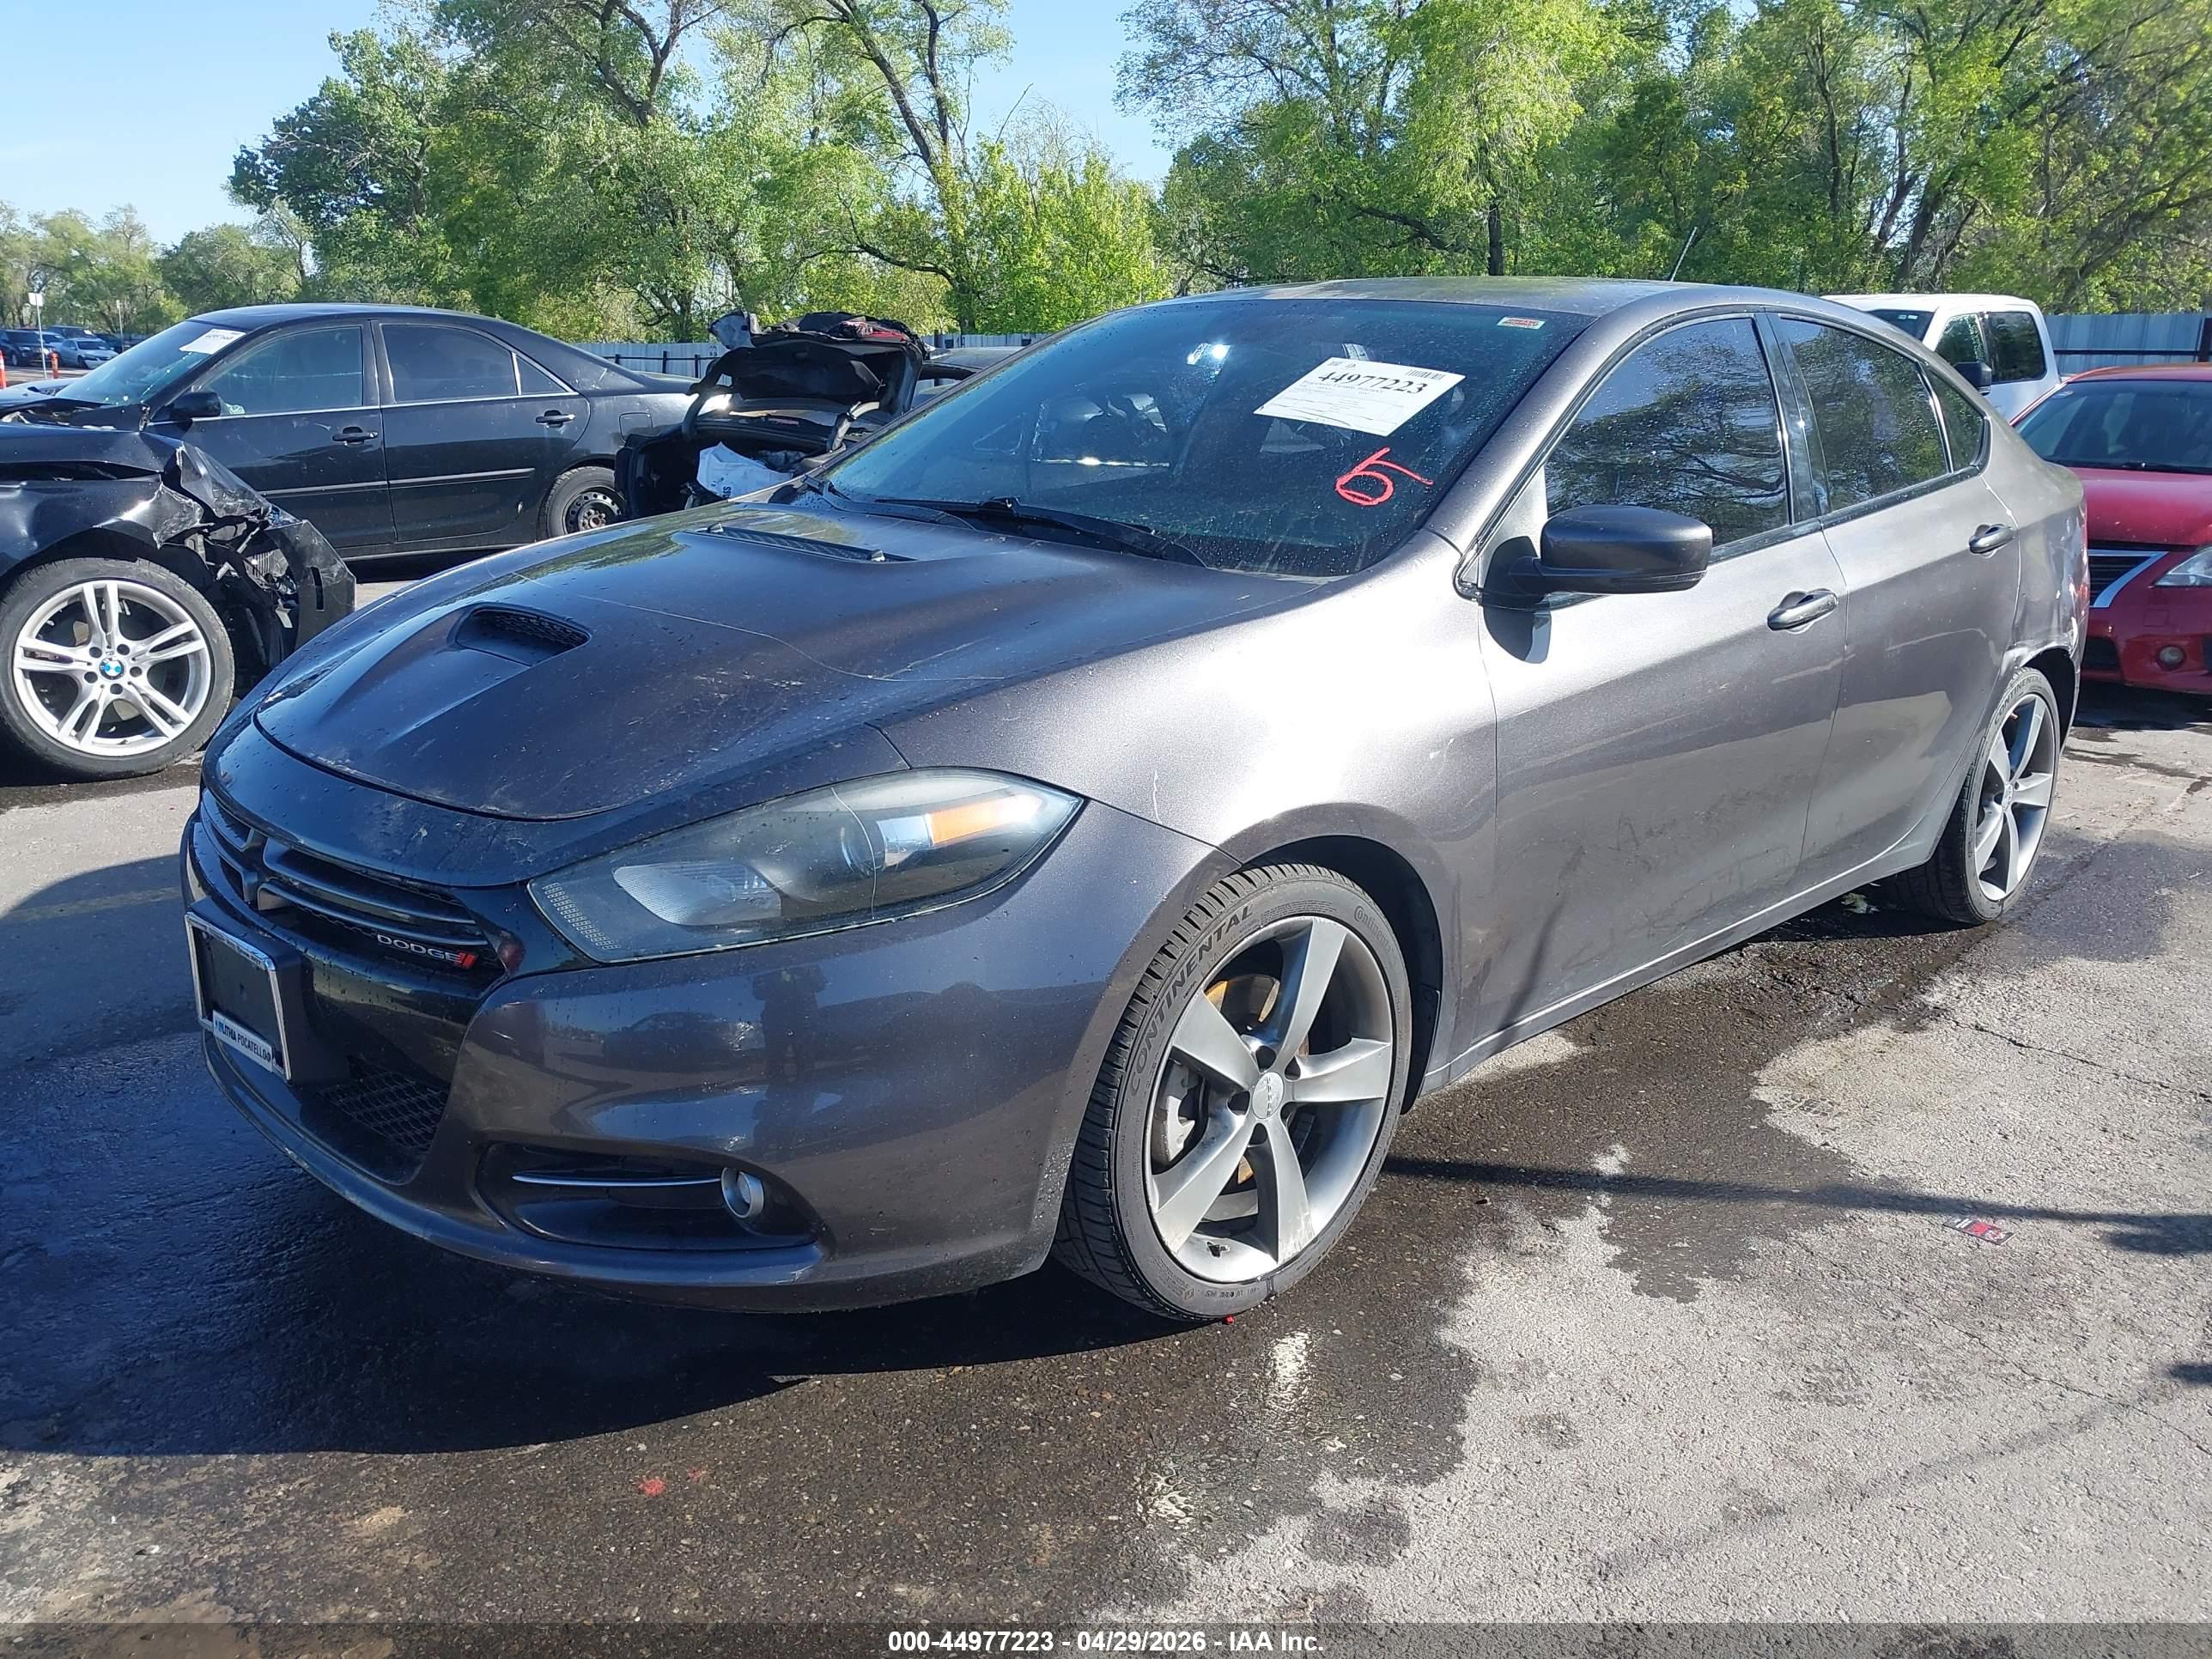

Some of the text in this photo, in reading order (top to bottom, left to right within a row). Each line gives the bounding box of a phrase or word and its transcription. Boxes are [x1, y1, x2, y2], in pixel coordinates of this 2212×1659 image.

[1318, 371, 1429, 394] 44977223
[377, 933, 462, 963] DODGE
[1129, 904, 1255, 1097] CONTINENTAL
[237, 1032, 267, 1060] POCATELLO
